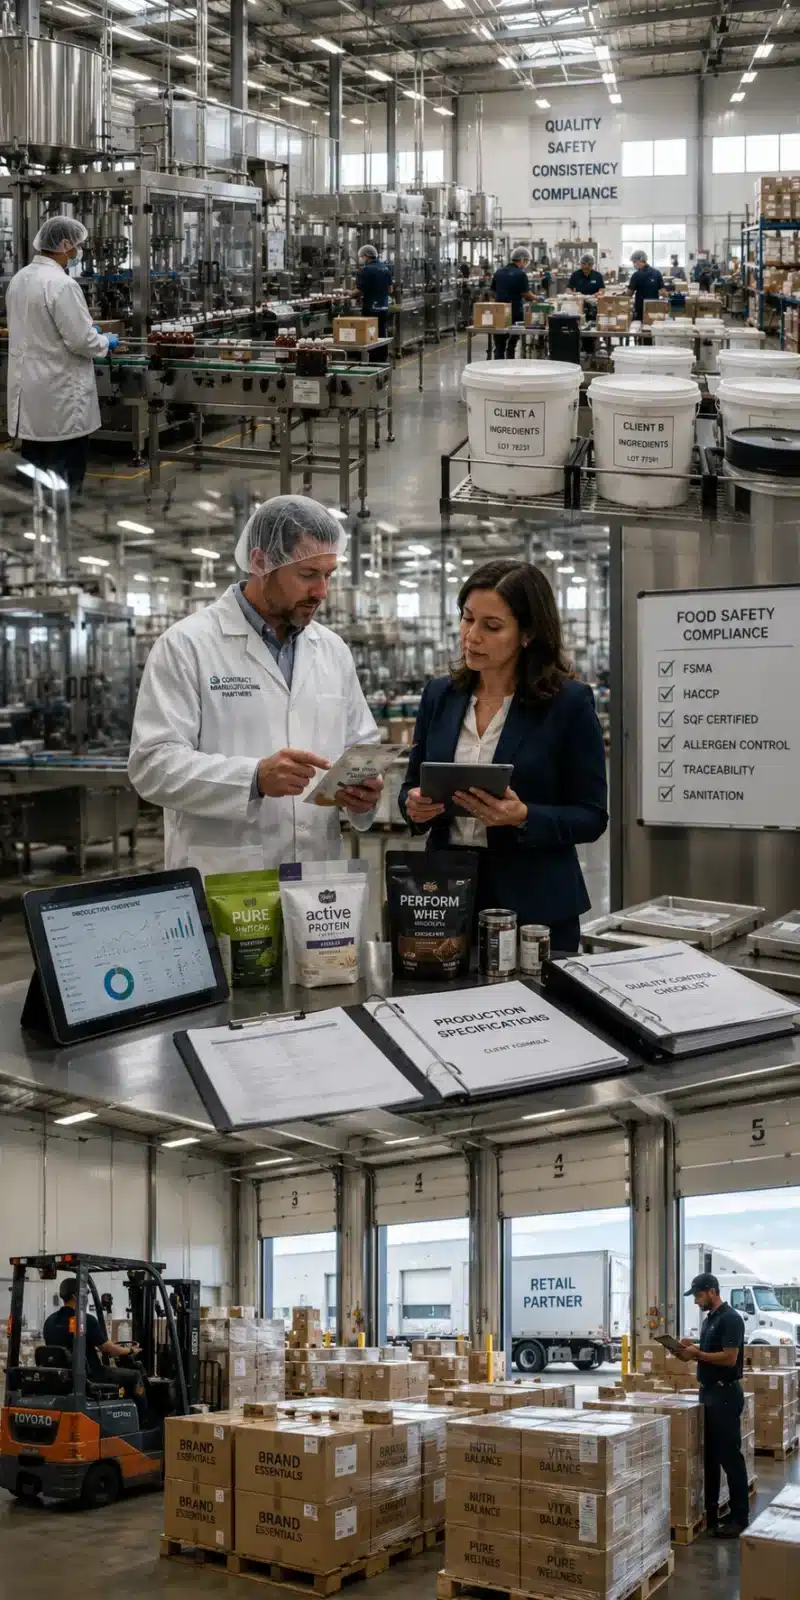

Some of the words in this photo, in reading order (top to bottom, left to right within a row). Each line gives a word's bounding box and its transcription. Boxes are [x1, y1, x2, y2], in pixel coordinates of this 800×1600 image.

[545, 117, 602, 132] QUALITY
[548, 140, 596, 154] SAFETY
[532, 162, 618, 177] CONSISTENCY
[532, 186, 618, 200] COMPLIANCE
[494, 408, 526, 418] CLIENT
[528, 410, 535, 418] A
[490, 426, 540, 435] INGREDIENTS
[623, 422, 656, 432] CLIENT
[658, 423, 664, 432] B
[619, 438, 668, 448] INGREDIENTS
[677, 610, 716, 623] FOOD
[721, 607, 775, 621] SAFETY
[683, 627, 768, 641] COMPLIANCE
[683, 664, 712, 674] FSMA
[683, 689, 719, 699] HACCP
[683, 715, 703, 725] SQF
[706, 715, 758, 724] CERTIFIED
[683, 740, 736, 750] ALLERGEN
[740, 740, 790, 750] CONTROL
[683, 764, 755, 775] TRACEABILITY
[683, 790, 744, 800] SANITATION
[400, 895, 459, 907] PERFORM
[232, 909, 270, 924] PURE
[306, 906, 351, 921] active
[414, 910, 447, 920] WHEY
[309, 922, 349, 933] PROTEIN
[625, 979, 667, 990] QUALITY
[434, 1006, 526, 1026] PRODUCTION
[437, 1014, 550, 1038] SPECIFICATIONS
[483, 1045, 510, 1054] CLIENT
[752, 1118, 765, 1141] 5
[530, 1276, 576, 1291] RETAIL
[524, 1295, 582, 1308] PARTNER
[180, 1439, 214, 1454] BRAND
[258, 1451, 300, 1468] BRAND
[464, 1452, 502, 1466] BALANCE
[548, 1448, 572, 1461] VITA
[255, 1465, 303, 1480] ESSENTIALS
[179, 1496, 214, 1513] BRAND
[470, 1492, 496, 1504] NUTRI
[464, 1503, 500, 1517] BALANCE
[548, 1502, 572, 1515] VITA
[258, 1512, 300, 1529] BRAND
[256, 1525, 302, 1542] ESSENTIALS
[470, 1541, 495, 1554] PURE
[547, 1555, 576, 1570] PURE
